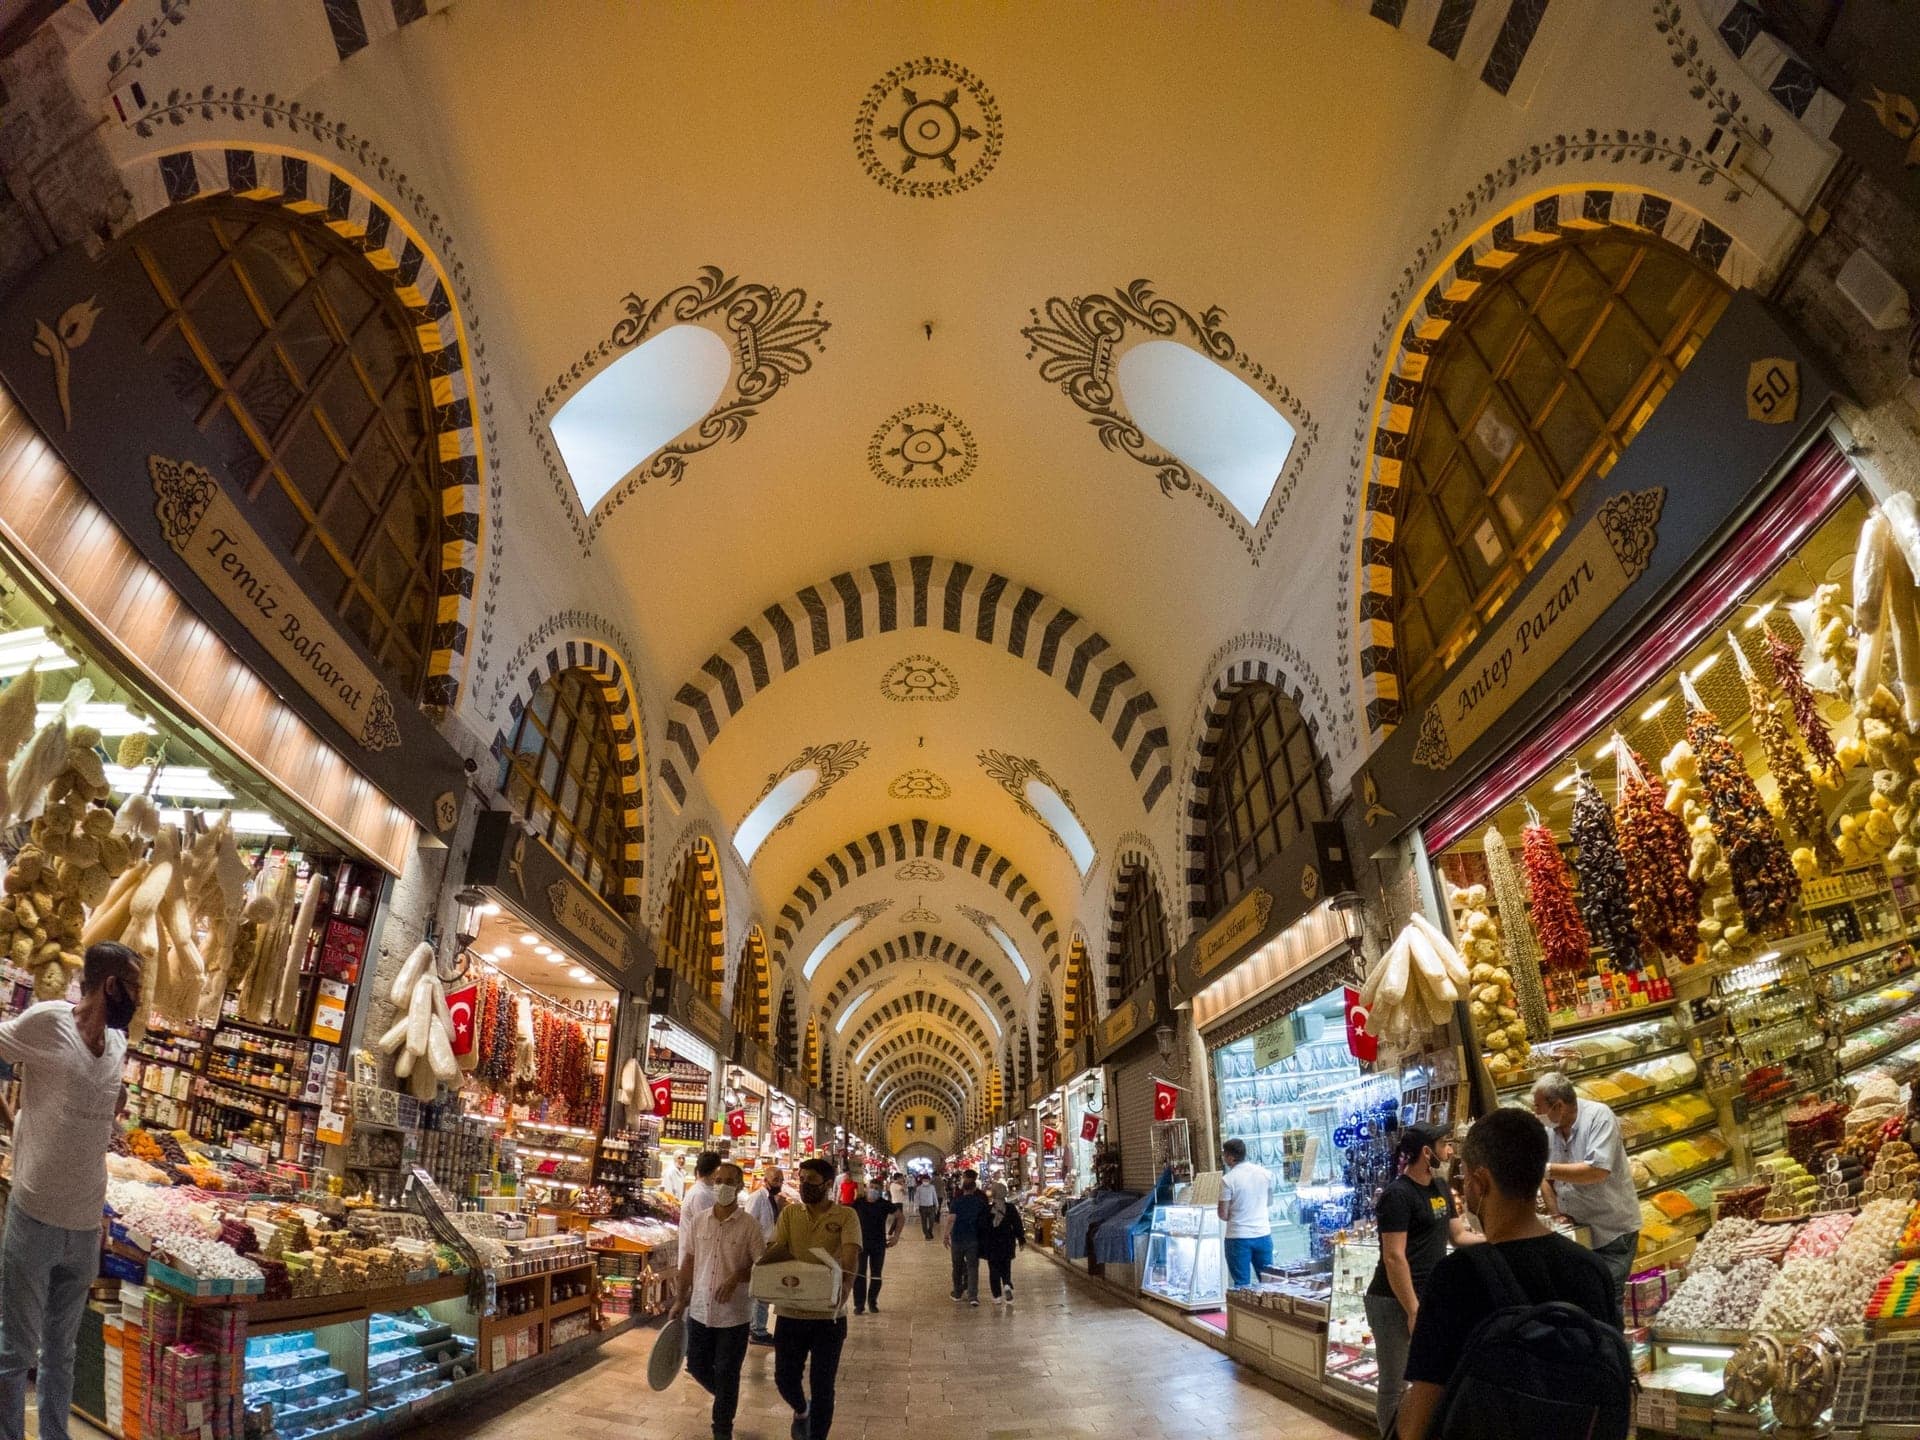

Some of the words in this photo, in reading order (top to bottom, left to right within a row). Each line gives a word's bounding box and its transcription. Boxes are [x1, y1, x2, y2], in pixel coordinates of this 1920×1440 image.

[1751, 366, 1790, 415] 50
[206, 528, 278, 619] Temiz
[279, 613, 363, 711] Baharat
[1457, 647, 1513, 721] Antep
[1516, 559, 1595, 654] Pazarı
[440, 801, 455, 823] 43
[1303, 871, 1315, 892] 52
